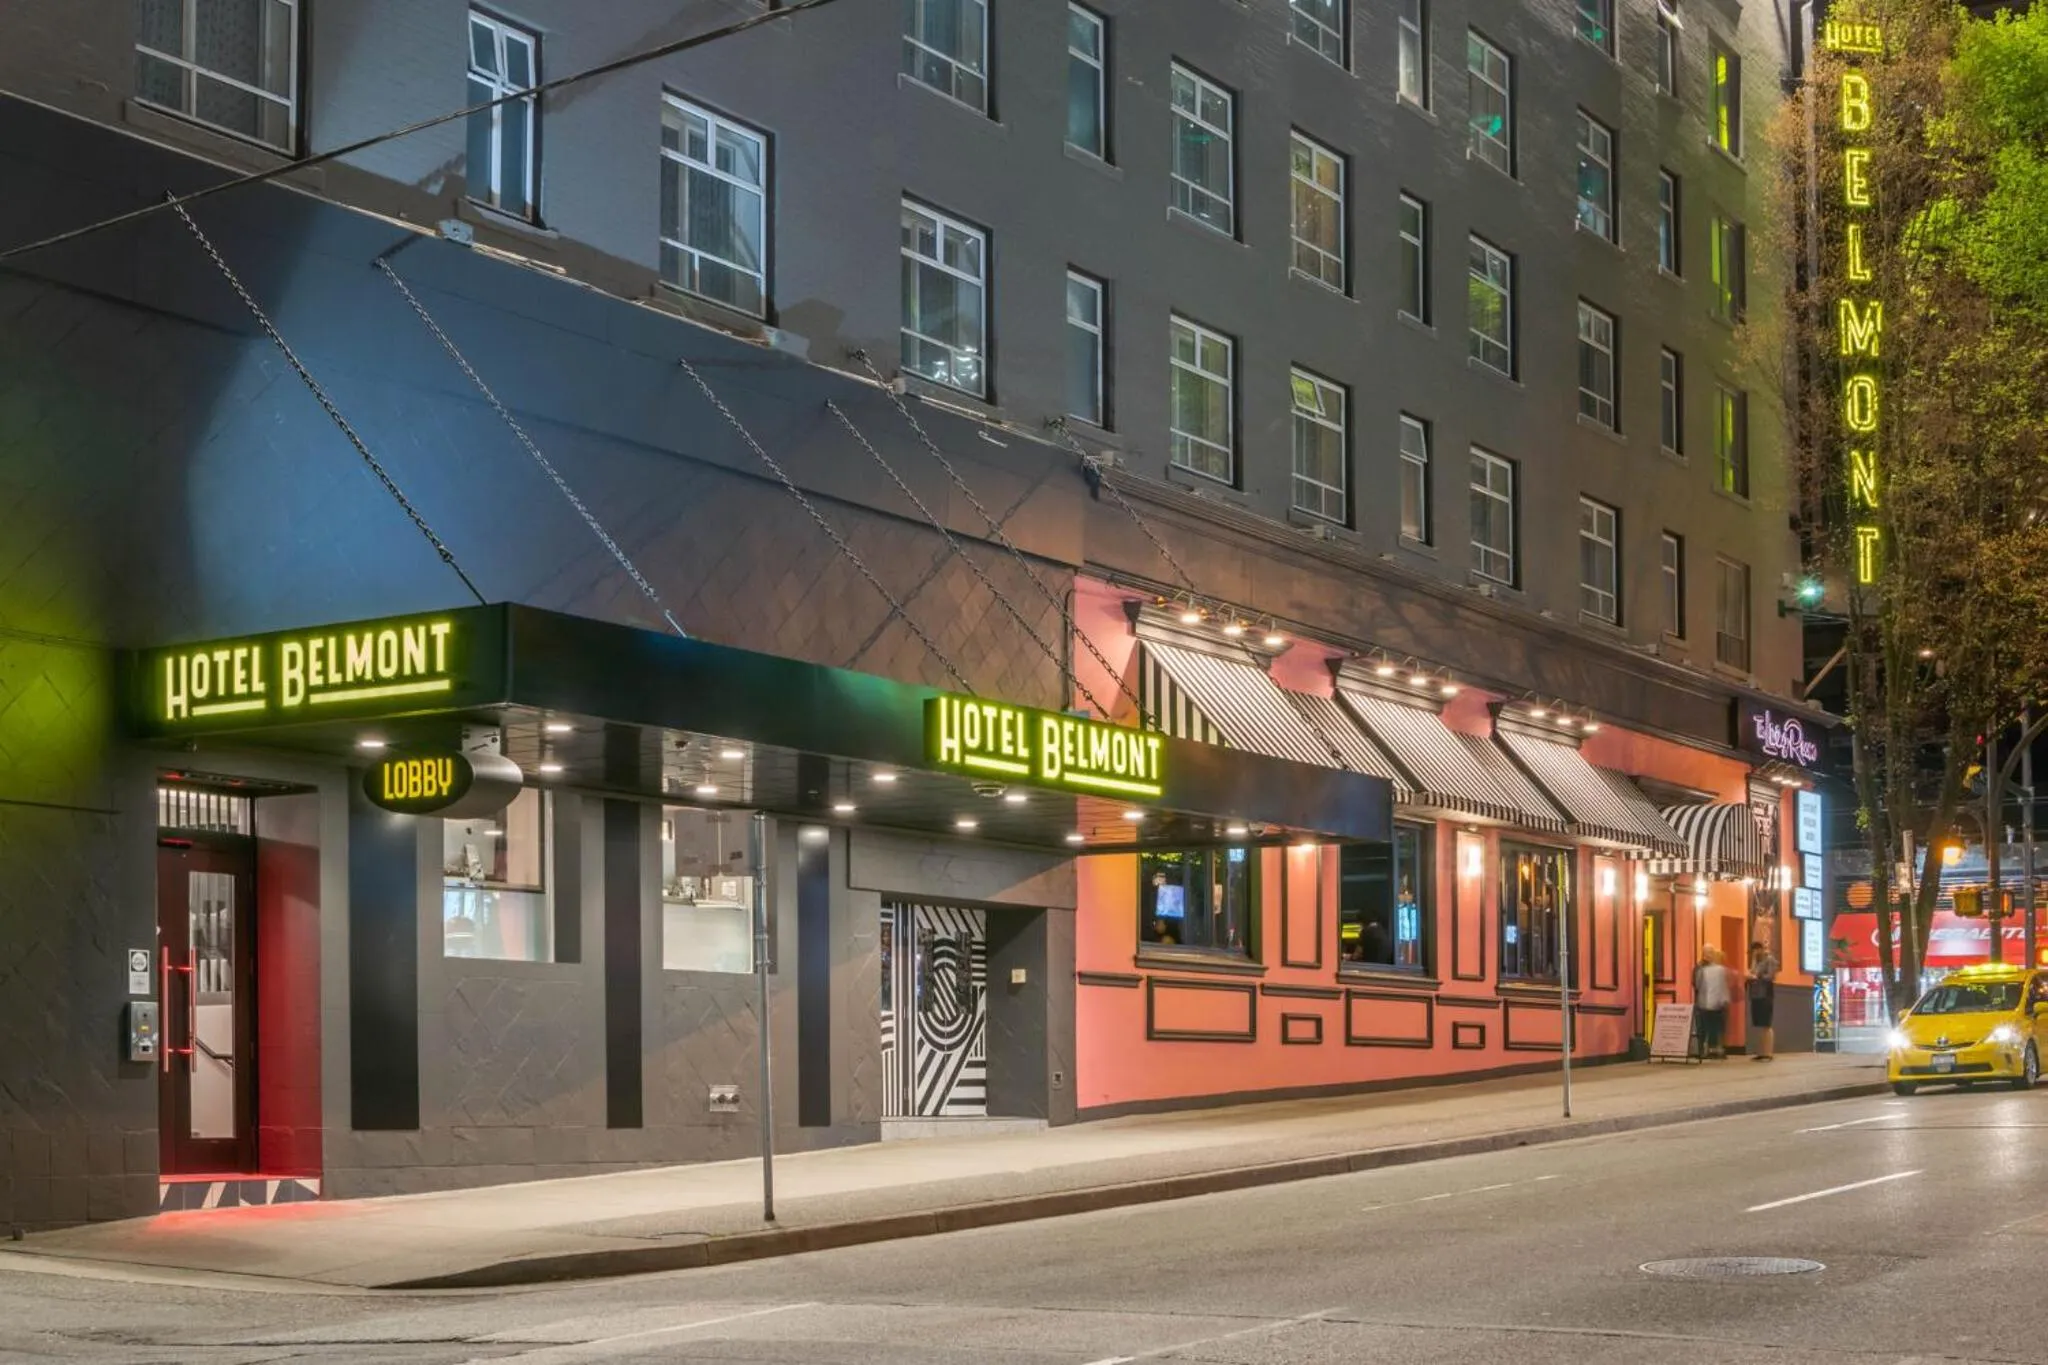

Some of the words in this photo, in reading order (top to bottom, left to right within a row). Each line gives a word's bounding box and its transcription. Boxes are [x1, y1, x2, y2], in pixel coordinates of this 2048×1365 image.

[1826, 22, 1882, 50] HOTEL
[1841, 74, 1881, 583] BELMONT
[165, 646, 265, 719] HOTEL
[282, 622, 450, 706] BELMONT
[384, 759, 452, 800] LOBBY
[940, 697, 1029, 770] HOTEL
[1043, 717, 1161, 787] BELMONT
